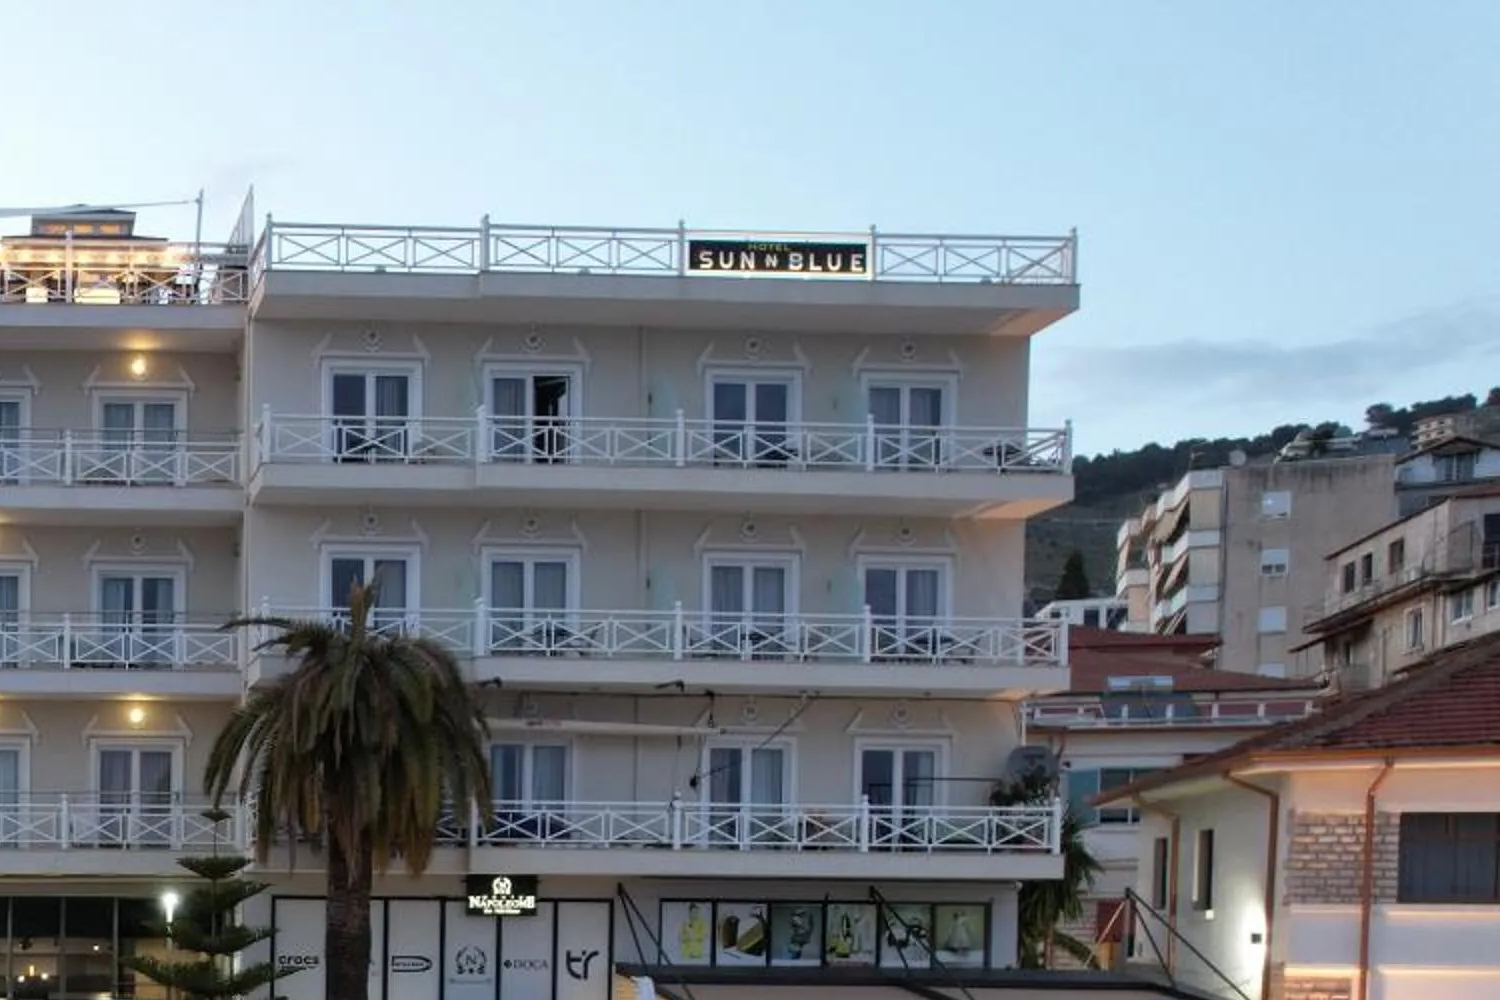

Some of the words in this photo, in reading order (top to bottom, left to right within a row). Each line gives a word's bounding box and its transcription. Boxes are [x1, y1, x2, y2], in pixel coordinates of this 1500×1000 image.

[699, 251, 755, 269] SUN
[788, 253, 864, 272] BLUE
[278, 955, 320, 965] crocs
